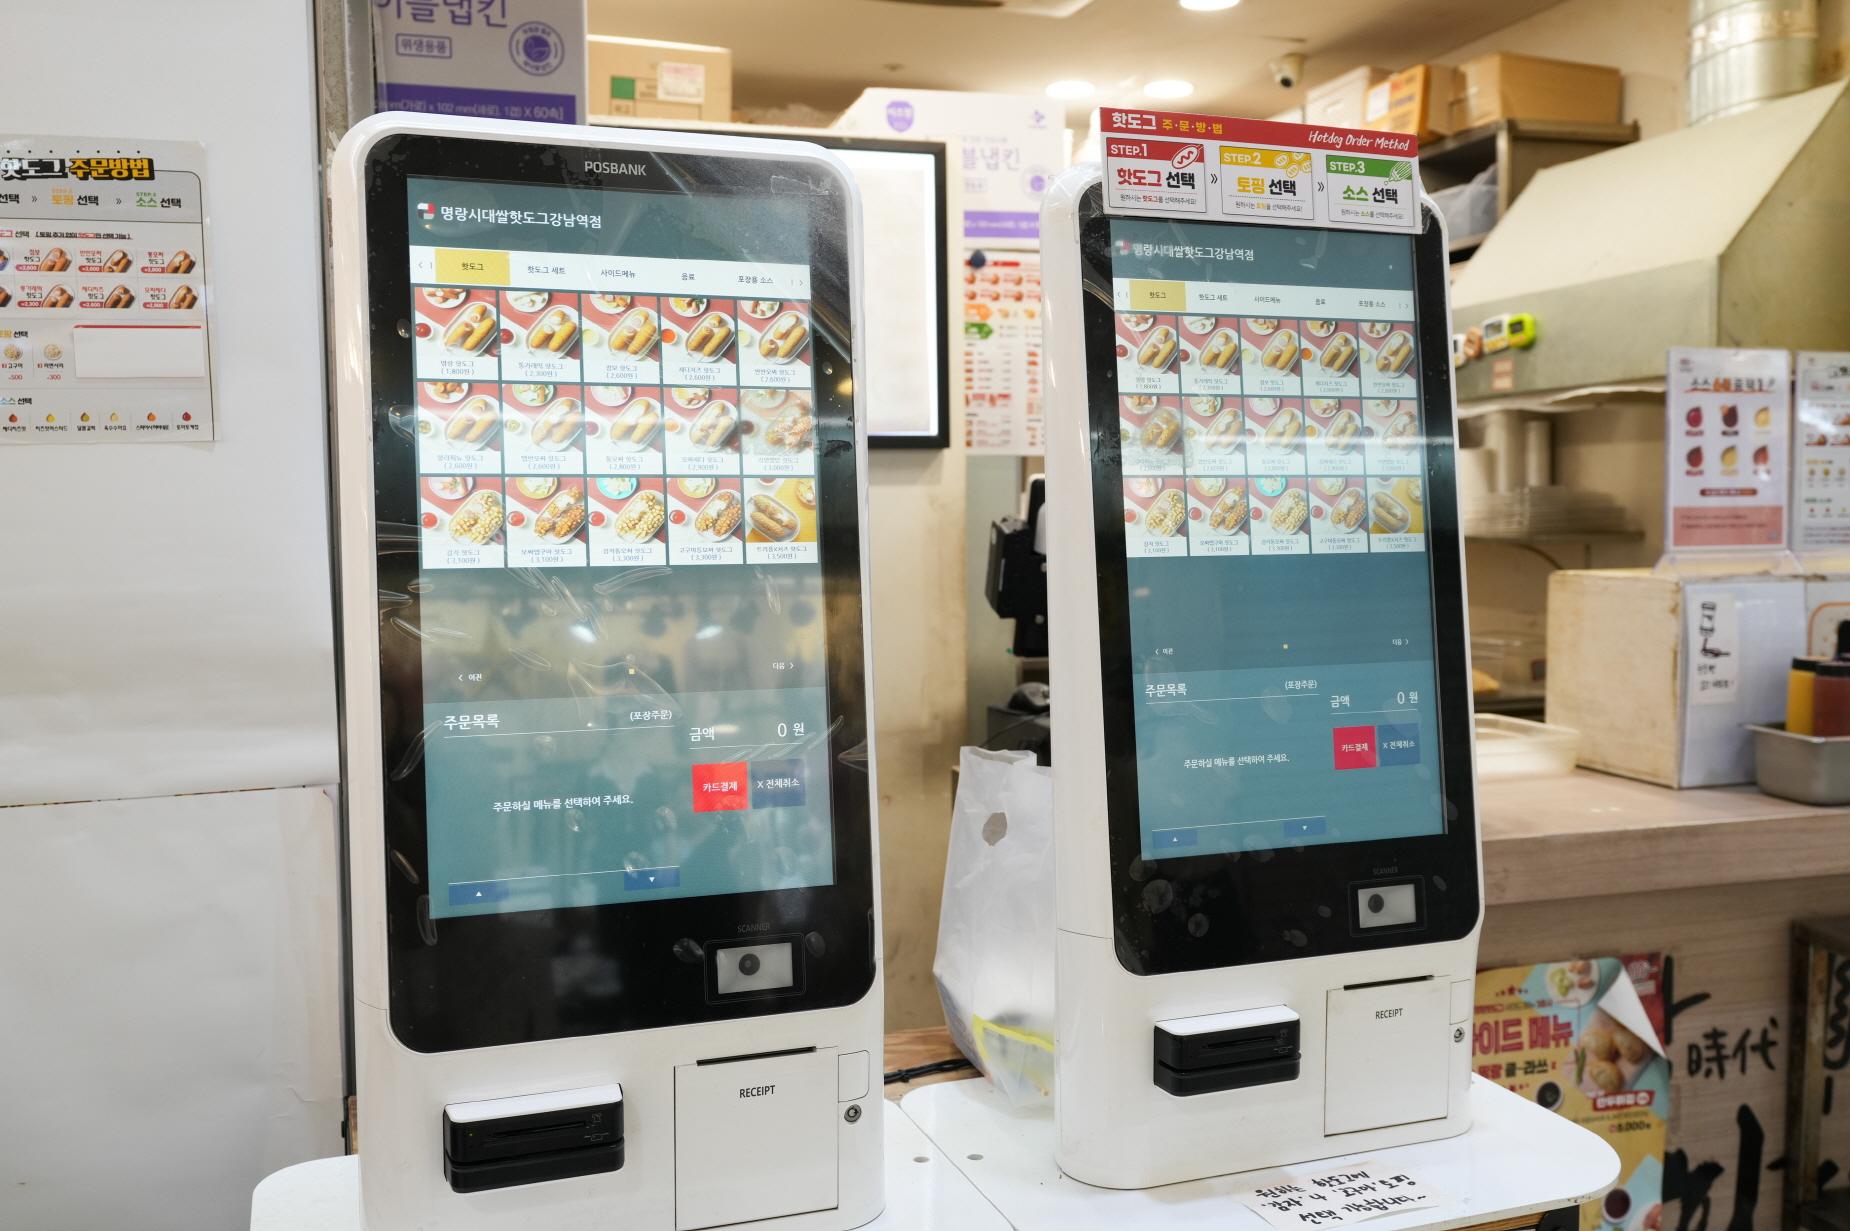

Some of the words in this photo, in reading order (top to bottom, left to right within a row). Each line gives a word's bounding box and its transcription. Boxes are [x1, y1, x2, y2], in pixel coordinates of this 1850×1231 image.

[1111, 112, 1157, 130] 핫도그
[1308, 130, 1343, 148] Hotdog
[1345, 134, 1373, 148] Order
[1374, 137, 1409, 151] Method
[1111, 143, 1148, 157] STEP.1
[1223, 151, 1262, 165] STEP.2
[0, 158, 66, 180] 핫도그
[69, 158, 154, 180] 주문방법
[584, 160, 646, 176] POSBANK
[1329, 160, 1366, 174] STEP.3
[1117, 168, 1162, 187] 핫도그
[1166, 172, 1195, 189] 선택
[1237, 176, 1265, 195] 토핑
[1269, 178, 1297, 196] 선택
[0, 193, 20, 204] 선택
[76, 194, 99, 206] 선택
[1343, 184, 1369, 201] 소스
[1372, 187, 1398, 204] 선택
[136, 198, 158, 208] 소스
[160, 196, 182, 208] 선택
[440, 206, 602, 230] 명랑시대쌀핫도그강남역점
[461, 261, 484, 272] 핫도그
[527, 265, 549, 275] 핫도그
[551, 266, 567, 276] 세트
[600, 268, 637, 280] 사이드메뉴
[681, 272, 696, 282] 음료
[760, 276, 774, 285] 소스
[17, 397, 33, 405] 선택
[772, 661, 785, 670] 다음
[468, 673, 482, 681] 이전
[1145, 683, 1187, 698] 주문목록
[1285, 680, 1318, 690] (포장주문)
[1330, 695, 1351, 708] 금액
[1397, 691, 1405, 705] 0
[1408, 691, 1419, 704] 원
[443, 713, 500, 731] 주문목록
[629, 710, 673, 722] (포장주문)
[689, 726, 716, 742] 금액
[777, 722, 788, 738] 0
[792, 722, 805, 737] 원
[1341, 743, 1369, 752] 카드결제
[1184, 758, 1212, 769] 주문하실
[1213, 757, 1236, 768] 메뉴를
[1236, 755, 1265, 766] 선택하여
[1266, 753, 1290, 764] 주세요.
[702, 780, 738, 793] 카드결제
[765, 777, 801, 789] 전체취소
[493, 800, 531, 813] 주문하실
[533, 798, 562, 810] 메뉴를
[564, 796, 601, 809] 선택하여
[603, 794, 634, 806] 주세요.
[737, 923, 771, 934] SCANNER
[1375, 1008, 1404, 1021] RECEIPT
[1528, 1015, 1573, 1050] 메뉴
[739, 1084, 776, 1099] RECEIPT
[1255, 1184, 1306, 1198] 원하는
[1311, 1171, 1370, 1187] 핫도그에
